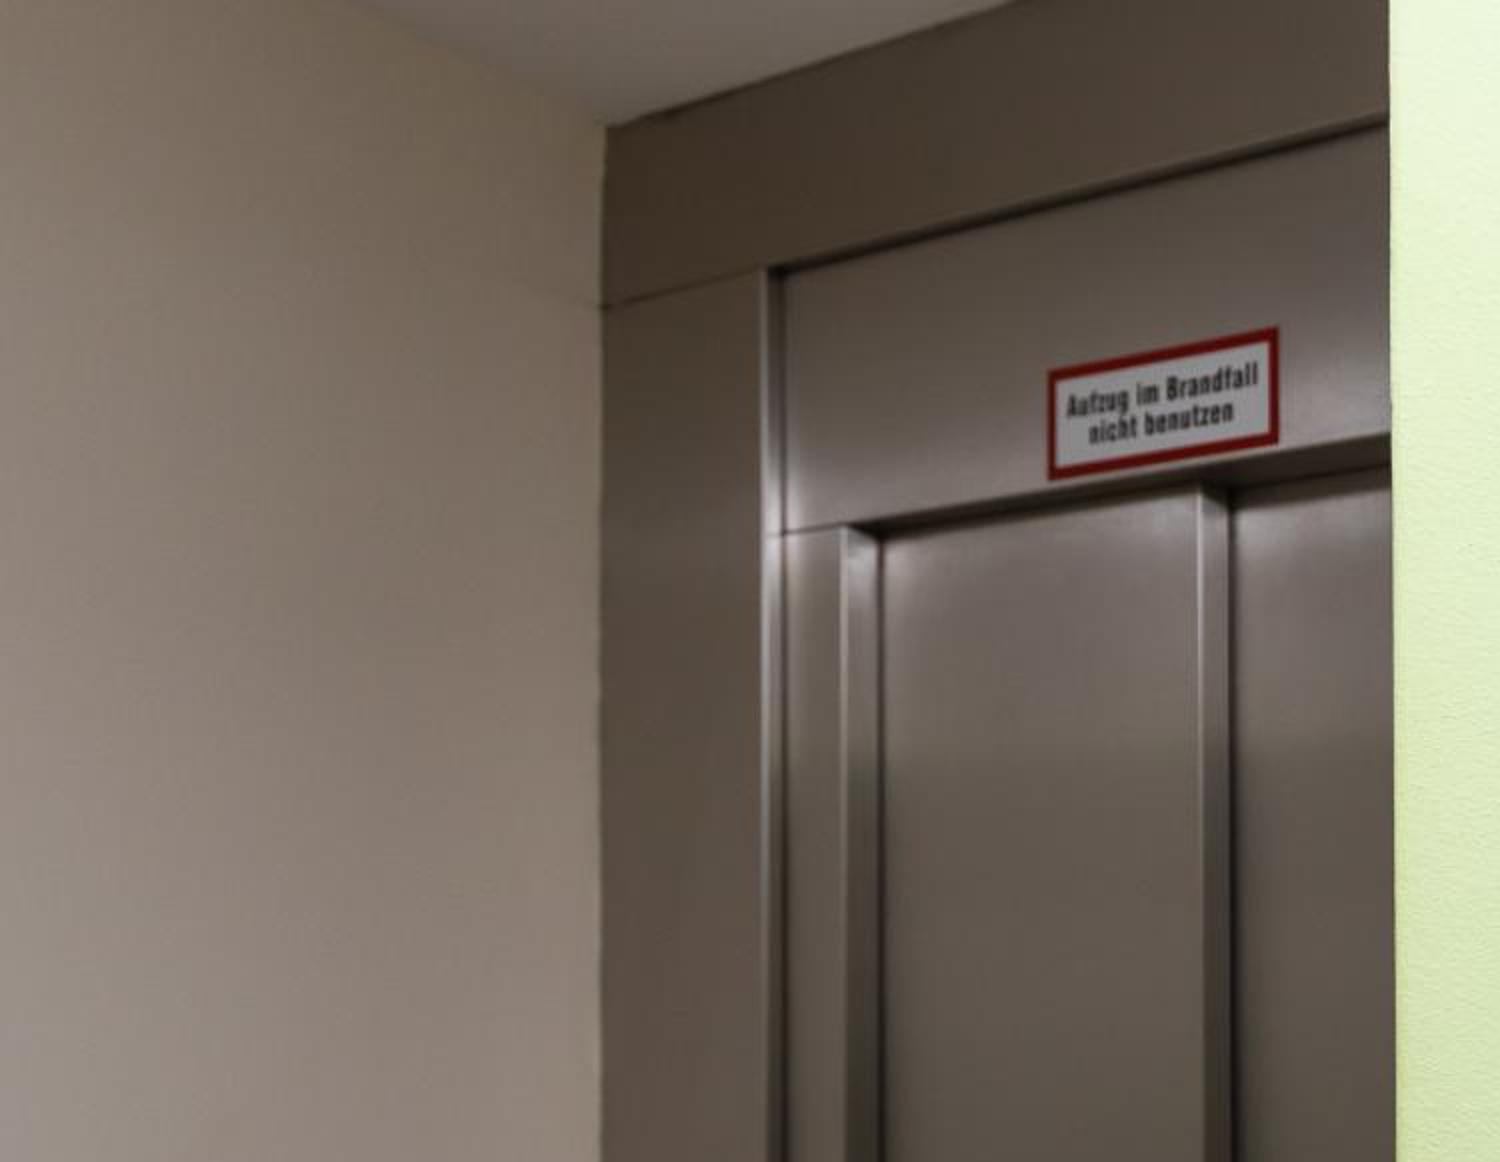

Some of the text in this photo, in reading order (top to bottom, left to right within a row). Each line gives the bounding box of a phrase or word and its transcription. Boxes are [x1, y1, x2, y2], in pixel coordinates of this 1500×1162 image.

[1066, 361, 1259, 419] Aufzug im Brandfall
[1088, 402, 1235, 445] nicht benutzen
